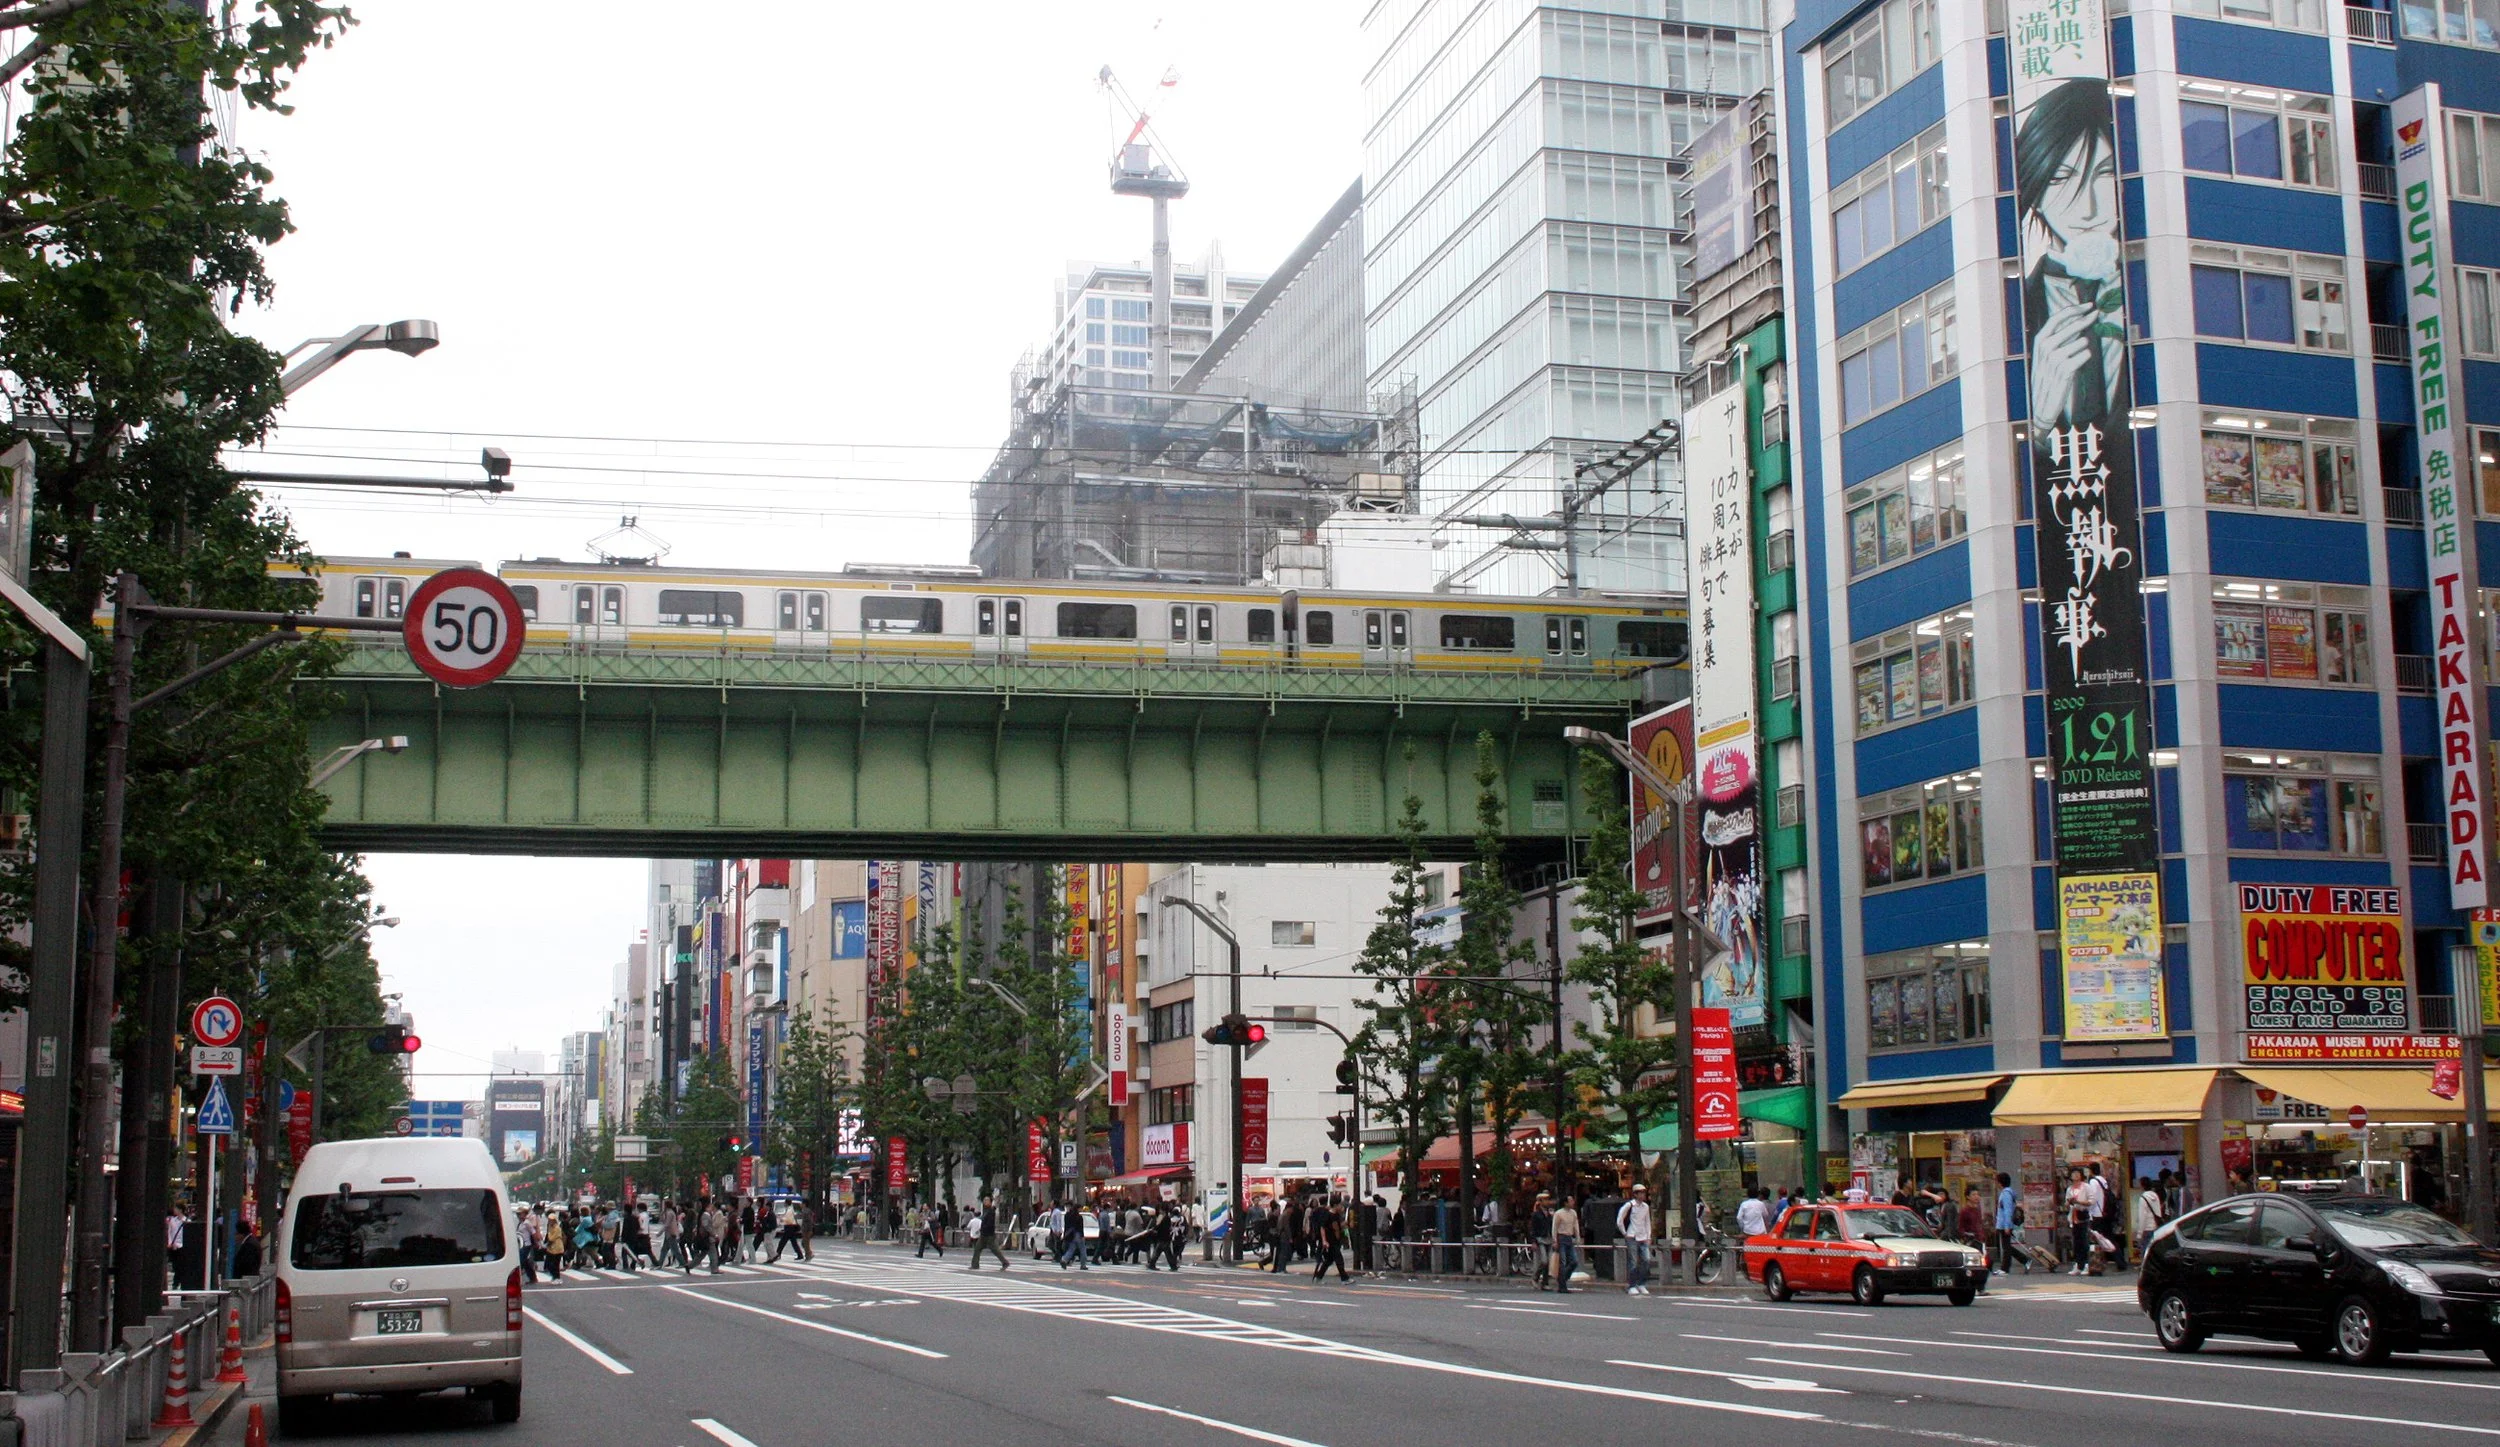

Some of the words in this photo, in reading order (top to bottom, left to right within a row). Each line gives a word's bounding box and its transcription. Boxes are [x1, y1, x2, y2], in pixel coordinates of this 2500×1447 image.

[2016, 11, 2053, 79] 満載
[2404, 179, 2438, 300] DUTY
[2415, 317, 2448, 436] FREE
[1723, 401, 1744, 558] サーカスが
[2425, 448, 2456, 559] 免税店
[2046, 422, 2133, 682] 黒執事
[434, 602, 498, 655] 50
[2053, 696, 2085, 711] 2009
[2060, 708, 2140, 767] 1.21
[2434, 572, 2482, 886] TAKARADA
[2062, 768, 2093, 785] DVD
[2096, 765, 2142, 783] Release
[2064, 879, 2154, 894] AKIHABARA
[2064, 892, 2152, 907] ゲーマーズ本店
[2241, 886, 2314, 912] DUTY
[2330, 887, 2401, 914] FREE
[2477, 910, 2486, 921] 2
[2247, 918, 2404, 981] COMPUTER
[2248, 986, 2404, 1000] ENGLISH
[2478, 946, 2493, 1021] COMPUTERS
[2248, 1000, 2346, 1014] BRAND
[2369, 1001, 2405, 1014] PC
[2250, 1015, 2293, 1028] LOWEST
[2297, 1015, 2334, 1028] PRICE
[2337, 1015, 2407, 1028] GUARANTEED
[1113, 1013, 1123, 1062] docomo
[2249, 1035, 2318, 1047] TAKARADA
[2325, 1036, 2366, 1047] MUSEN
[2372, 1037, 2406, 1048] DUTY
[2412, 1037, 2441, 1048] FREE
[2447, 1037, 2461, 1048] SH
[200, 1051, 206, 1060] 8
[221, 1051, 234, 1061] 20
[2250, 1049, 2302, 1058] ENGLISH
[2307, 1049, 2323, 1057] PC
[2332, 1050, 2381, 1058] CAMERA
[2386, 1050, 2395, 1058] &
[2399, 1050, 2461, 1058] ACCESSOR
[2284, 1103, 2327, 1118] FREE
[1063, 1145, 1074, 1158] P
[1145, 1137, 1171, 1155] docomo
[387, 1319, 421, 1332] 53-27
